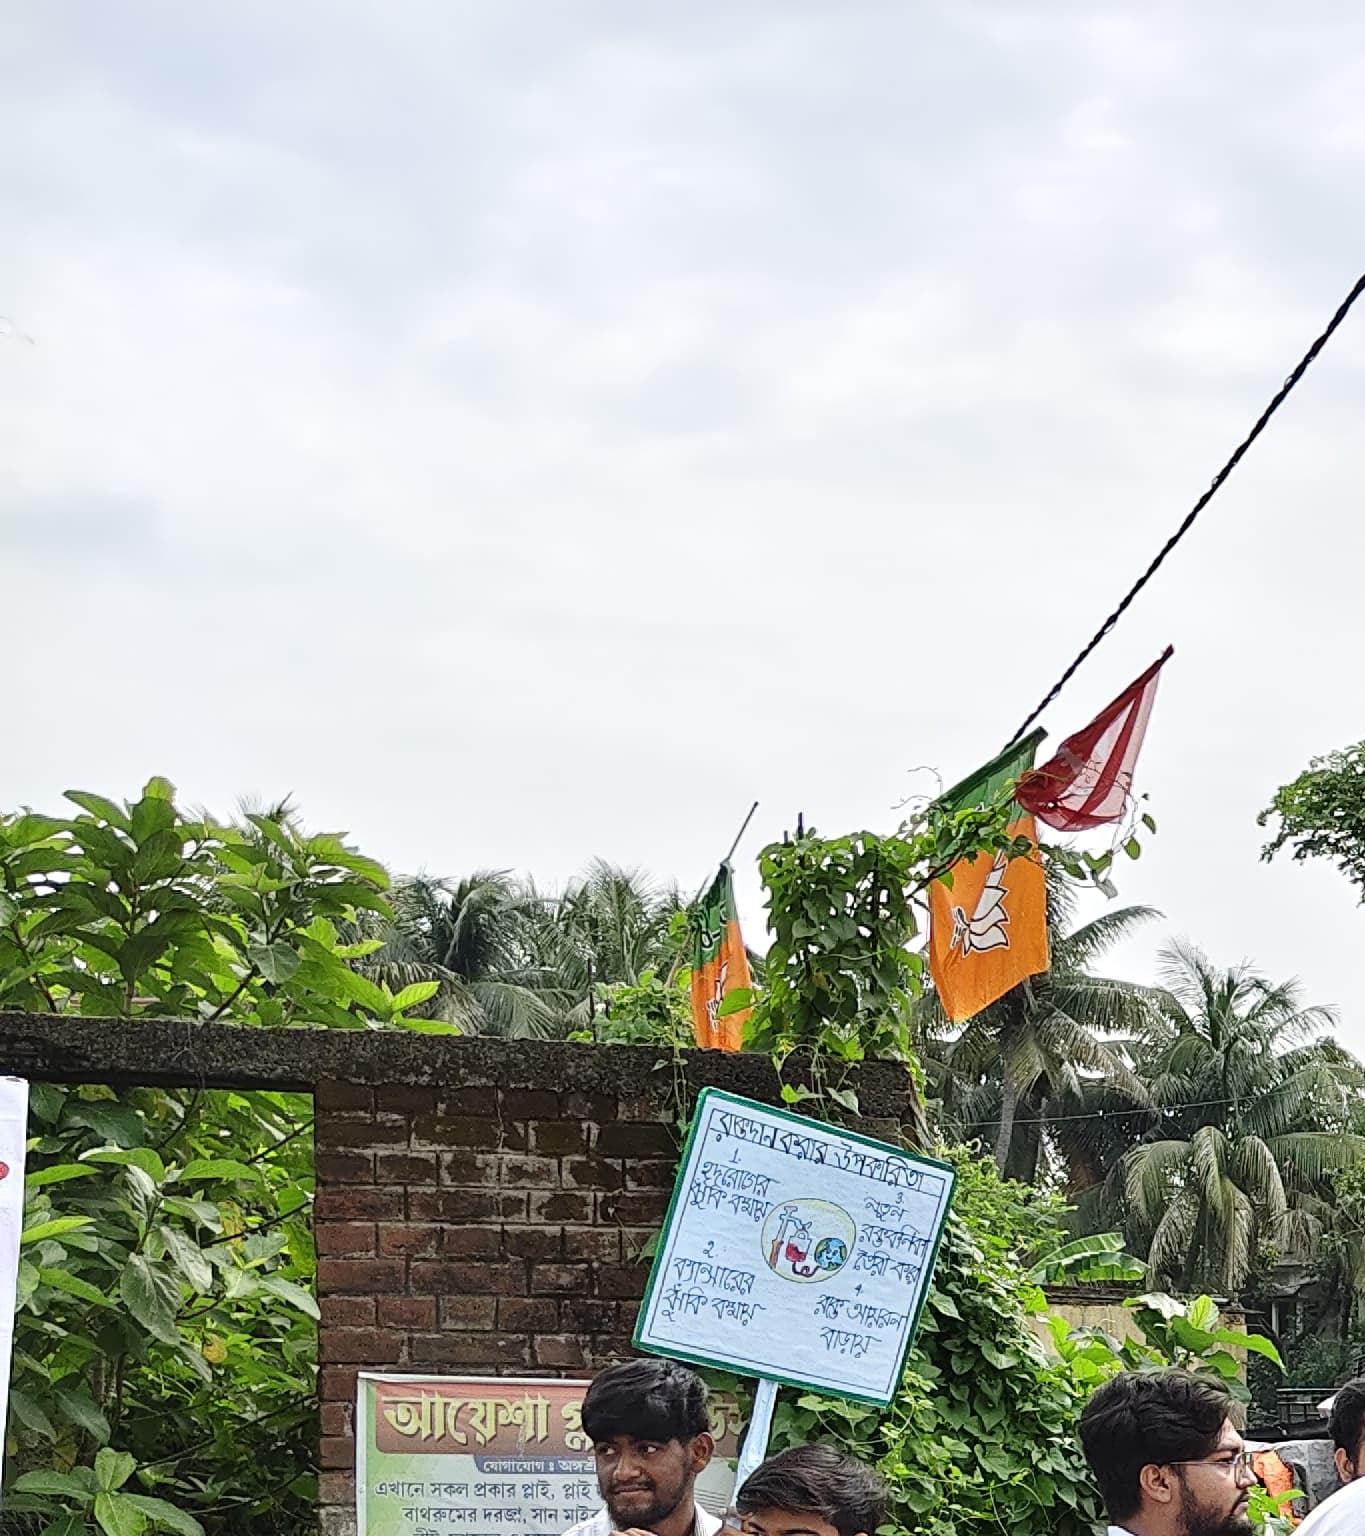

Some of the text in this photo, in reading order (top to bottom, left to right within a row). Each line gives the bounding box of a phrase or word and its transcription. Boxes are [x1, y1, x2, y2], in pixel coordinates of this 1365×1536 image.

[381, 1392, 551, 1446] আয়েশা
[376, 1481, 425, 1498] এখানে
[430, 1481, 469, 1499] সকল
[473, 1480, 517, 1500] প্রকার
[402, 1507, 478, 1524] বাথরুমের
[531, 1507, 559, 1524] সান
